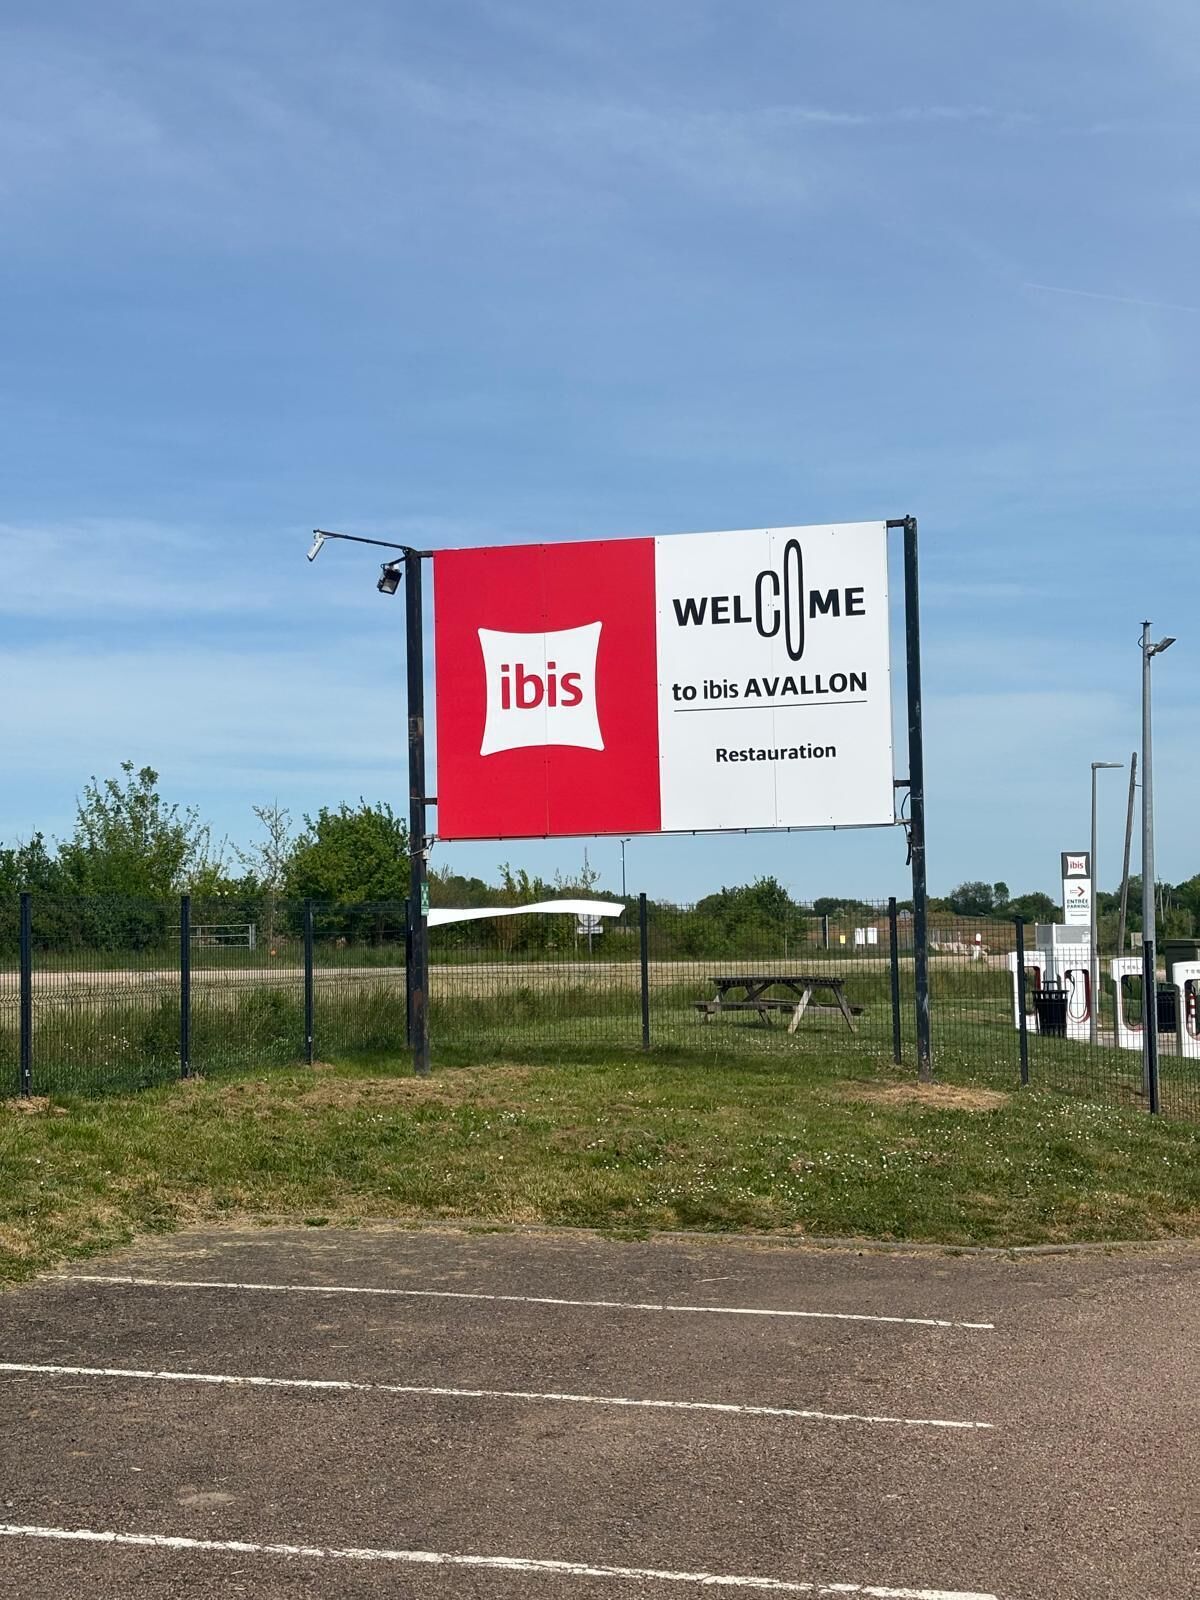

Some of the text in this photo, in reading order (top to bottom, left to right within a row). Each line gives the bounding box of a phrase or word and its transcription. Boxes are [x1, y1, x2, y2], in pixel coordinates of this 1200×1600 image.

[672, 538, 866, 662] WELCOME
[500, 661, 583, 710] ibis
[672, 671, 867, 702] to ibis AVALLON
[715, 743, 837, 763] Restauration
[1069, 860, 1084, 870] ibis
